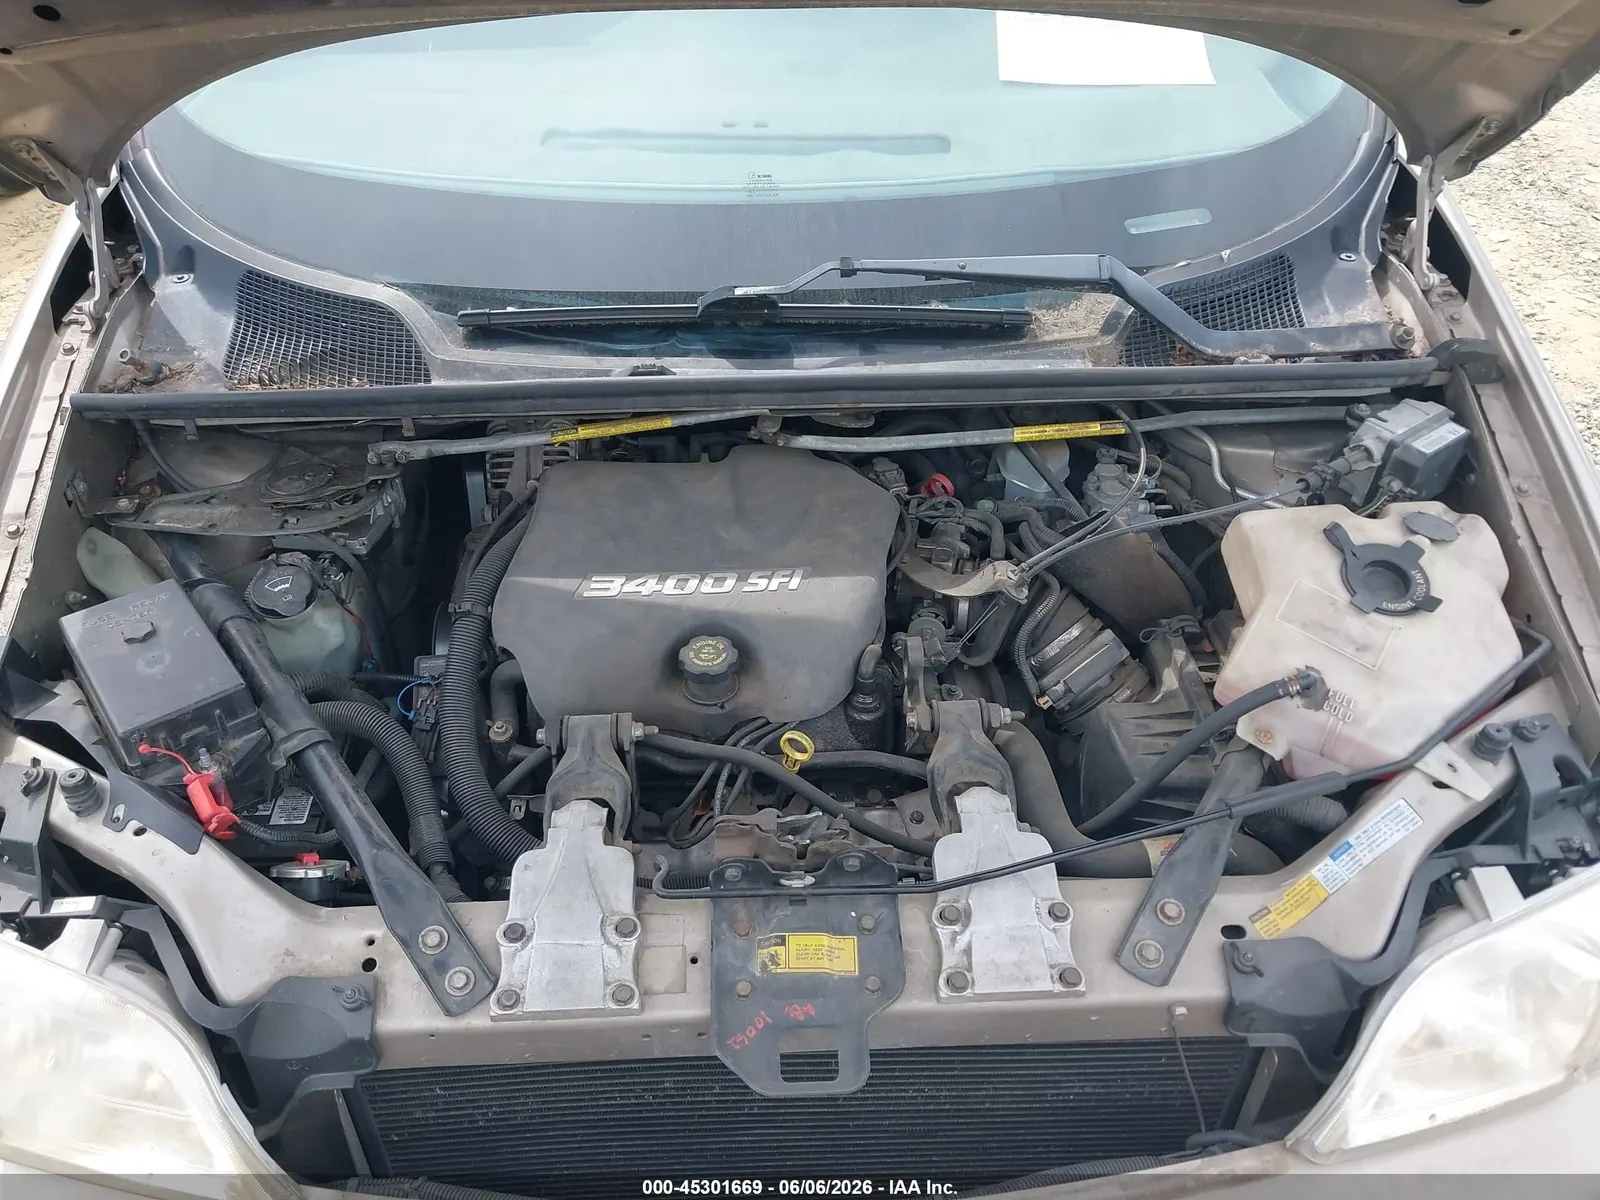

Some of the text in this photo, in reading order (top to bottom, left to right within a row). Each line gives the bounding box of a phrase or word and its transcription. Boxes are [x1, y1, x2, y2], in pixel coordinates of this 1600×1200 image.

[553, 428, 577, 436] CAUTION
[582, 569, 804, 598] 3400 SFI
[1382, 569, 1427, 611] ENGINE COOLANT
[81, 592, 170, 628] FUSE RELAY
[106, 608, 154, 631] CENTER
[692, 639, 718, 650] ENGINE
[1328, 687, 1357, 710] FULL
[1323, 699, 1354, 724] COLD
[761, 938, 782, 946] CAUTION
